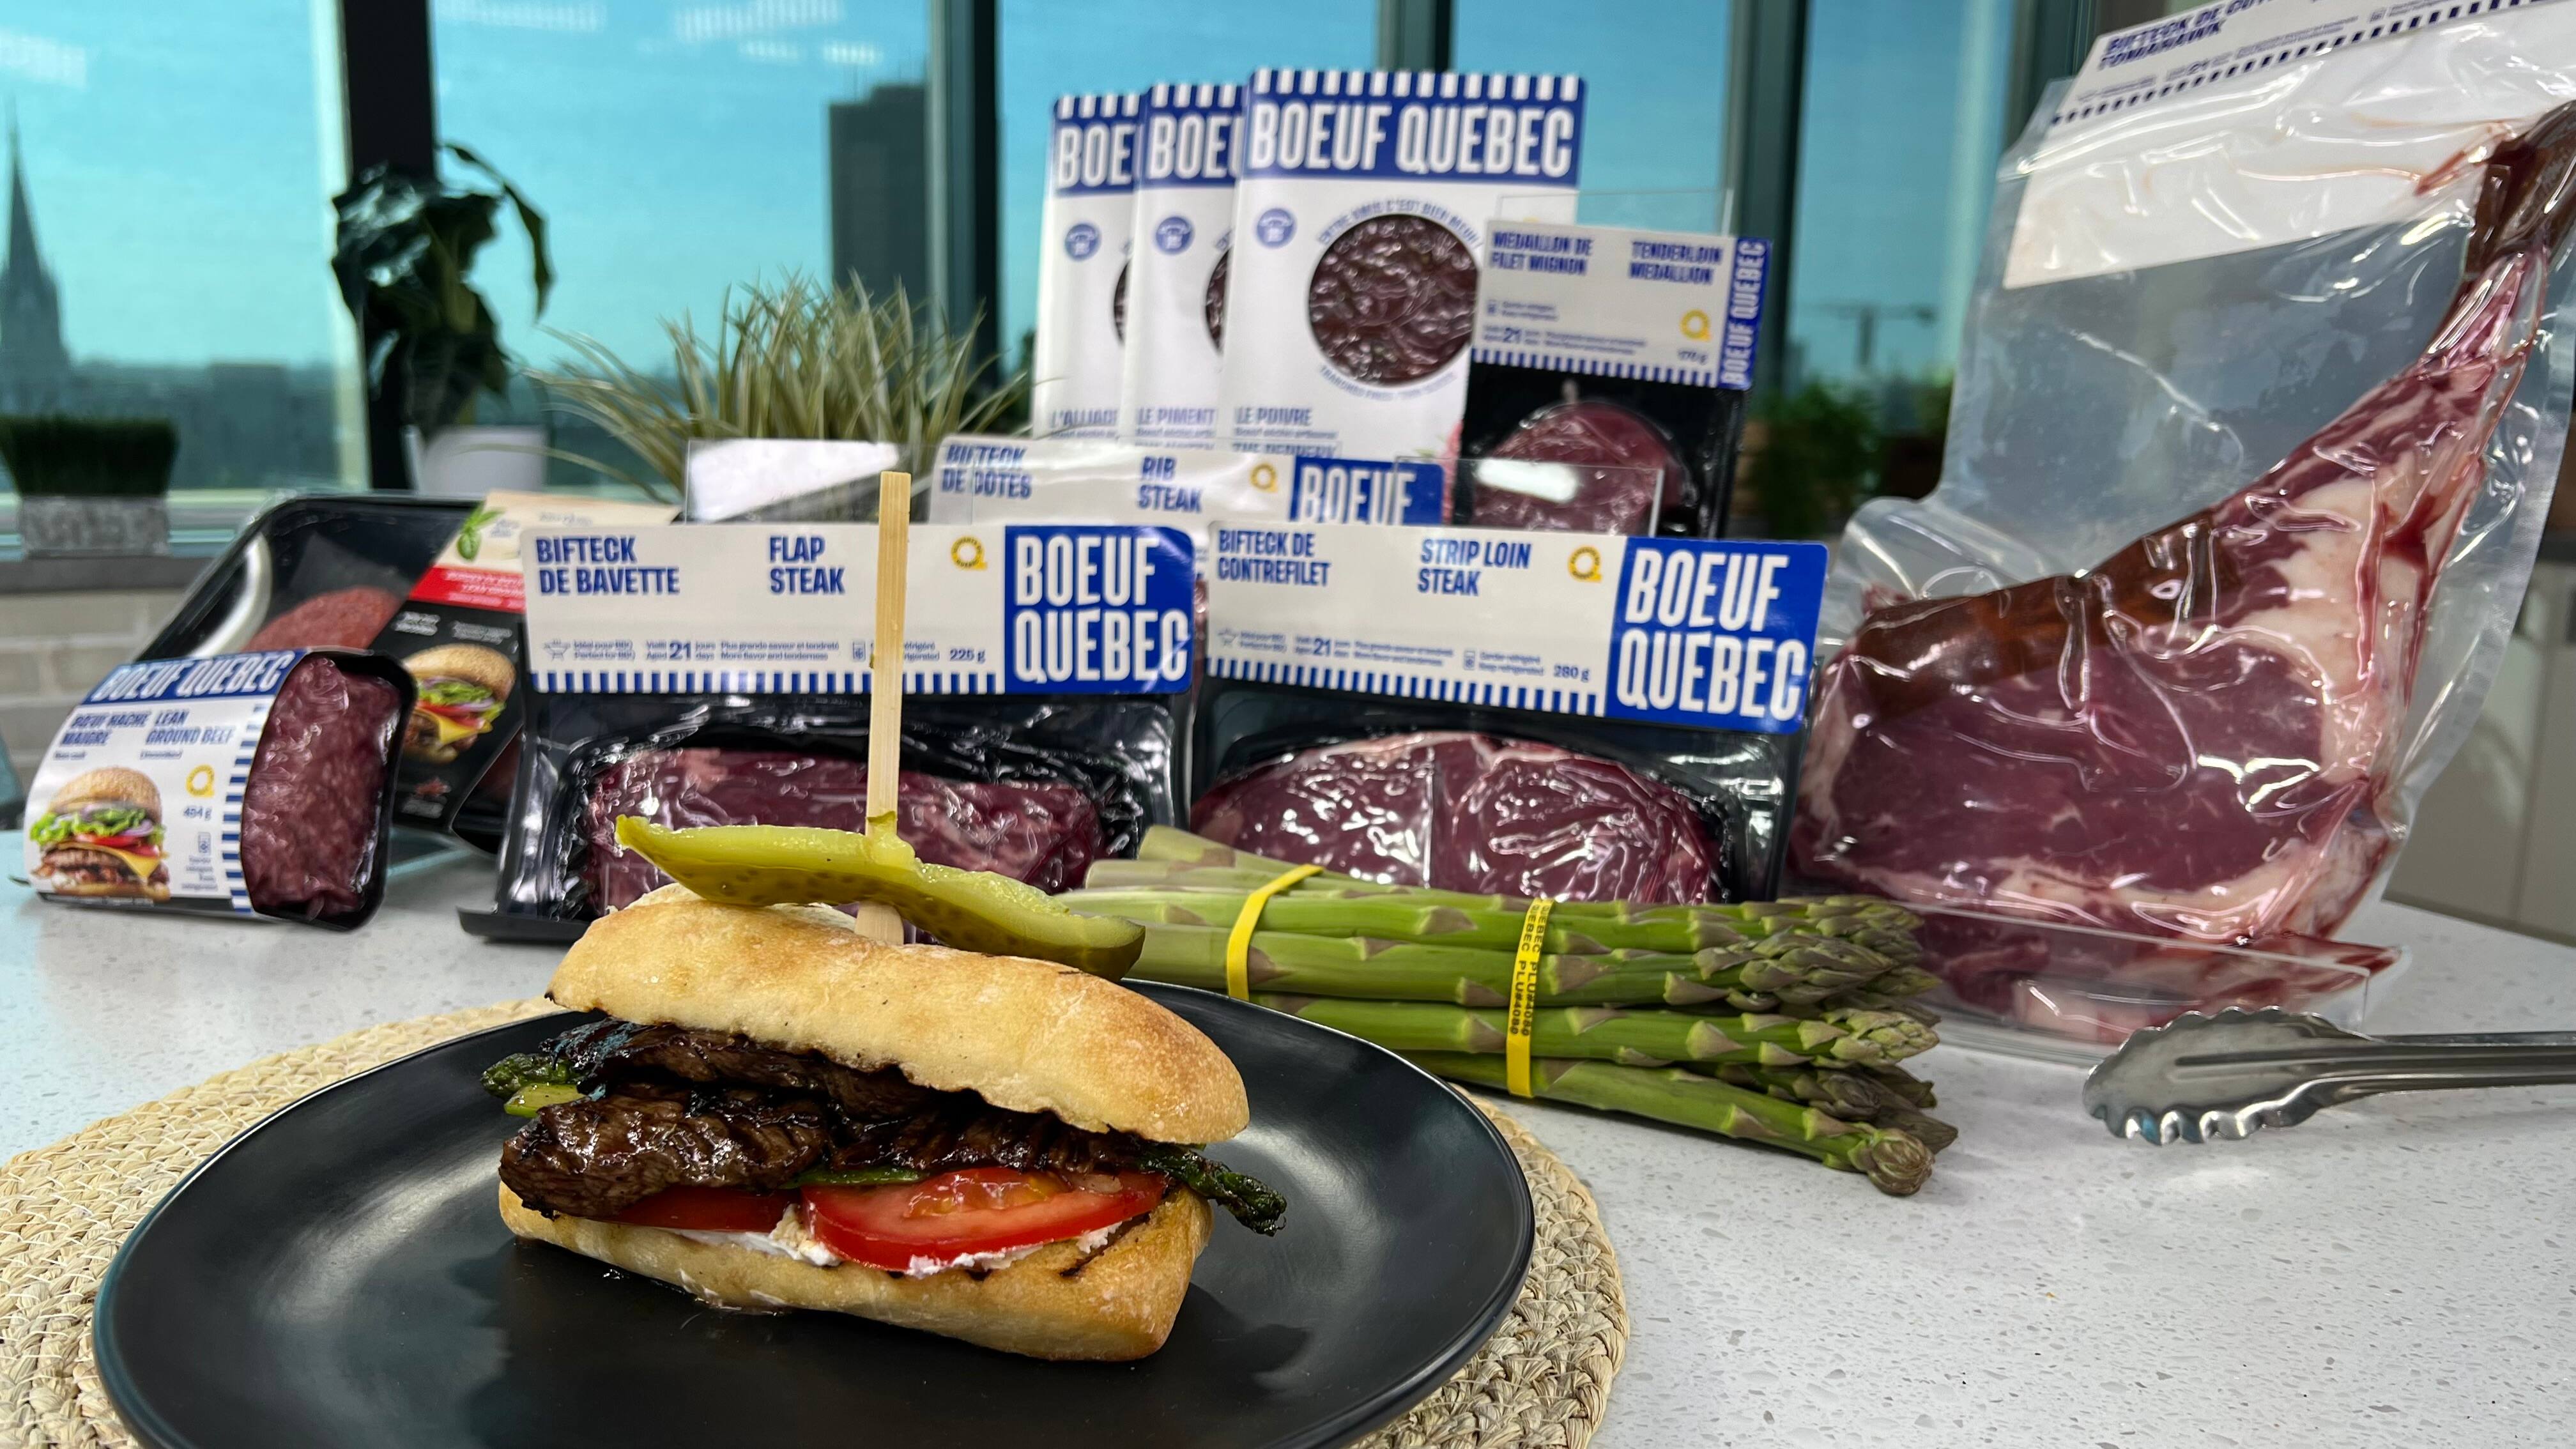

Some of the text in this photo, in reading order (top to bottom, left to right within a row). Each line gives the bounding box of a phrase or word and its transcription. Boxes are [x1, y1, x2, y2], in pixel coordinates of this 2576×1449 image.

[1149, 113, 1245, 180] BOE
[1248, 101, 1392, 171] BOEUF
[1056, 123, 1135, 189] BOE
[1575, 238, 1593, 256] DE
[1631, 240, 1722, 264] TENDERLOIN
[1490, 251, 1587, 275] FILET MIGNON
[1629, 262, 1713, 285] MEDALLION
[1721, 321, 1755, 385] BOEUF
[1157, 407, 1216, 425] PIMENT
[1236, 406, 1312, 426] LE POIVRE
[942, 469, 965, 493] DE
[1141, 456, 1177, 481] RIB
[1137, 484, 1203, 514] STEAK
[1296, 464, 1417, 526] BOEUF
[536, 535, 638, 564] BIFTECK
[769, 535, 825, 564] FLAP
[1218, 529, 1287, 556] BIFTECK
[1292, 533, 1315, 558] DE
[1420, 537, 1533, 569] STRIP LOIN
[539, 567, 572, 595] DE
[576, 566, 680, 595] BAVETTE
[769, 567, 846, 595] STEAK
[1015, 534, 1161, 606] BOEUF
[1217, 557, 1331, 586] CONTREFILET
[1417, 567, 1481, 596] STEAK
[1625, 548, 1790, 632] BOEUF
[668, 640, 691, 660] 21
[977, 650, 986, 664] g
[1313, 638, 1331, 656] 21
[91, 661, 192, 702] BOEUF
[1554, 664, 1590, 683] 280 g
[155, 710, 190, 726] LEAN
[146, 726, 235, 745] GROUND BEEF
